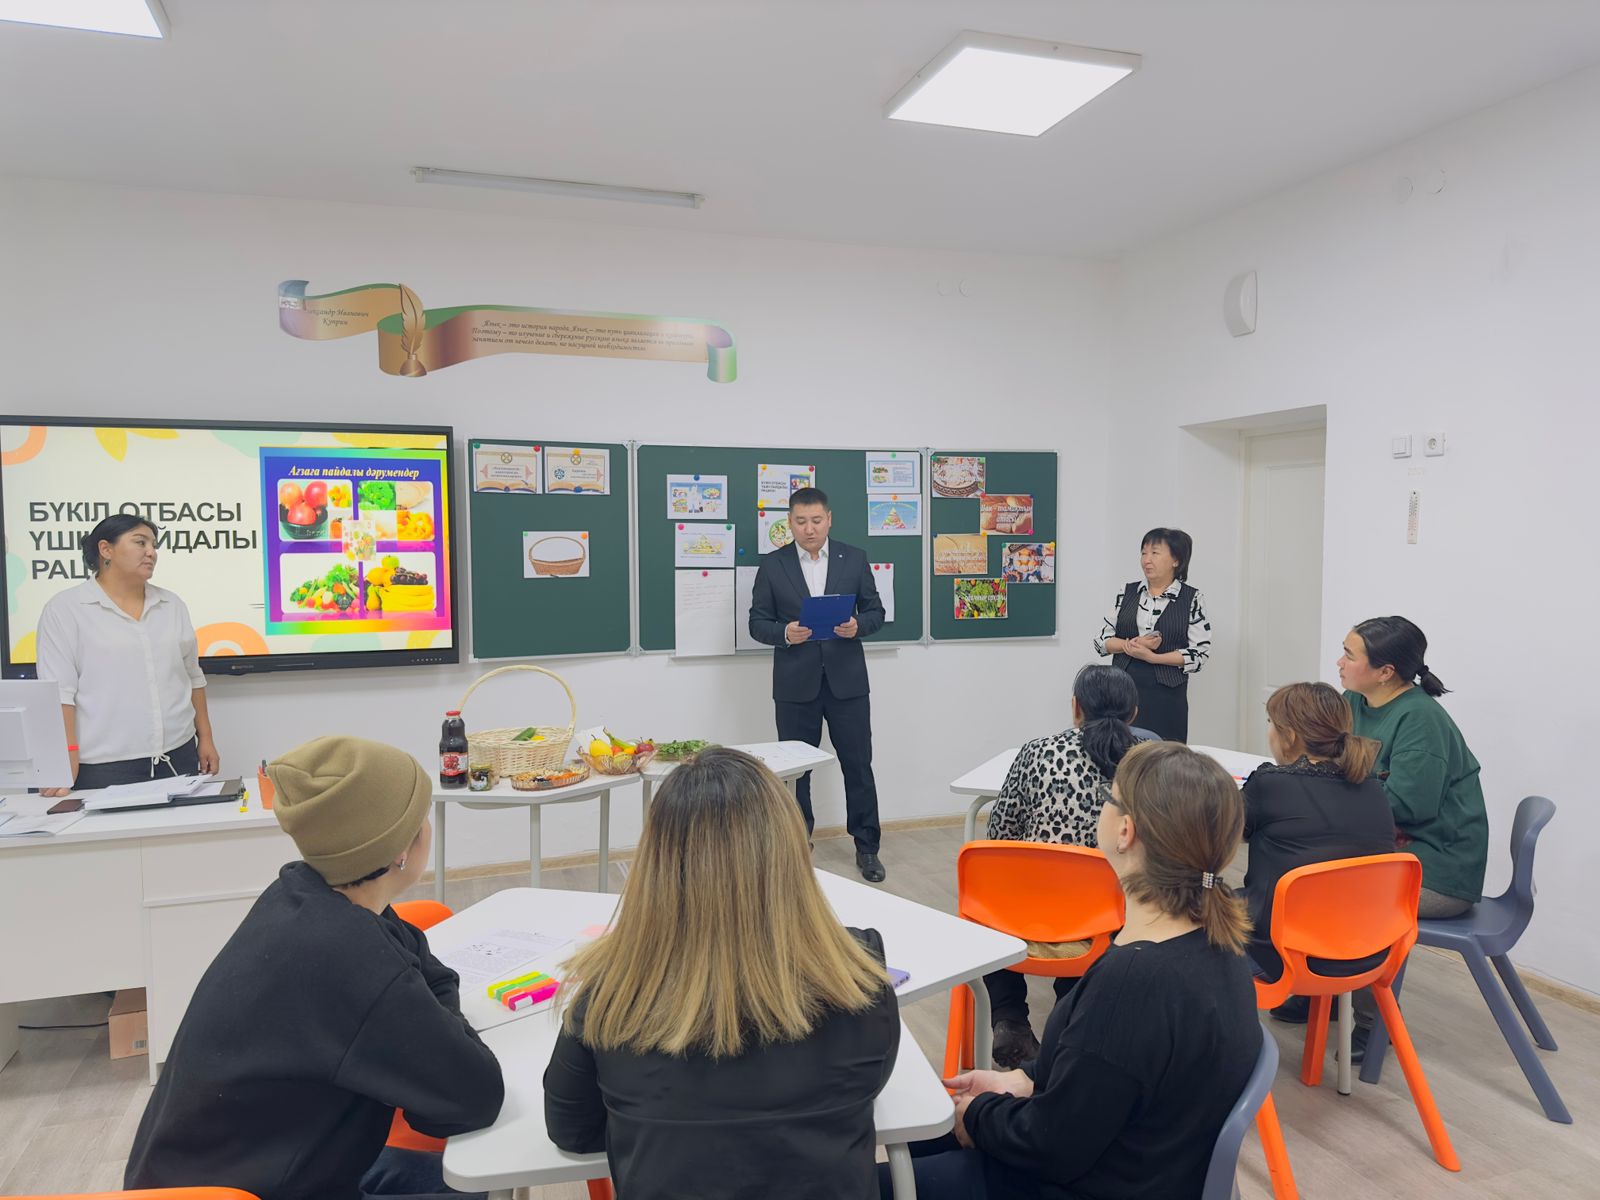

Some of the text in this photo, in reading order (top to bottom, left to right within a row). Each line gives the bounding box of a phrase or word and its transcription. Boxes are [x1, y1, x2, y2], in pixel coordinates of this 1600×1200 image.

[322, 466, 364, 478] пайдалы
[29, 502, 242, 522] БҮКІЛ ОТБАСЫ
[29, 526, 256, 553] ҮШІ ЙДАЛЫ
[32, 560, 90, 580] РАЦ
